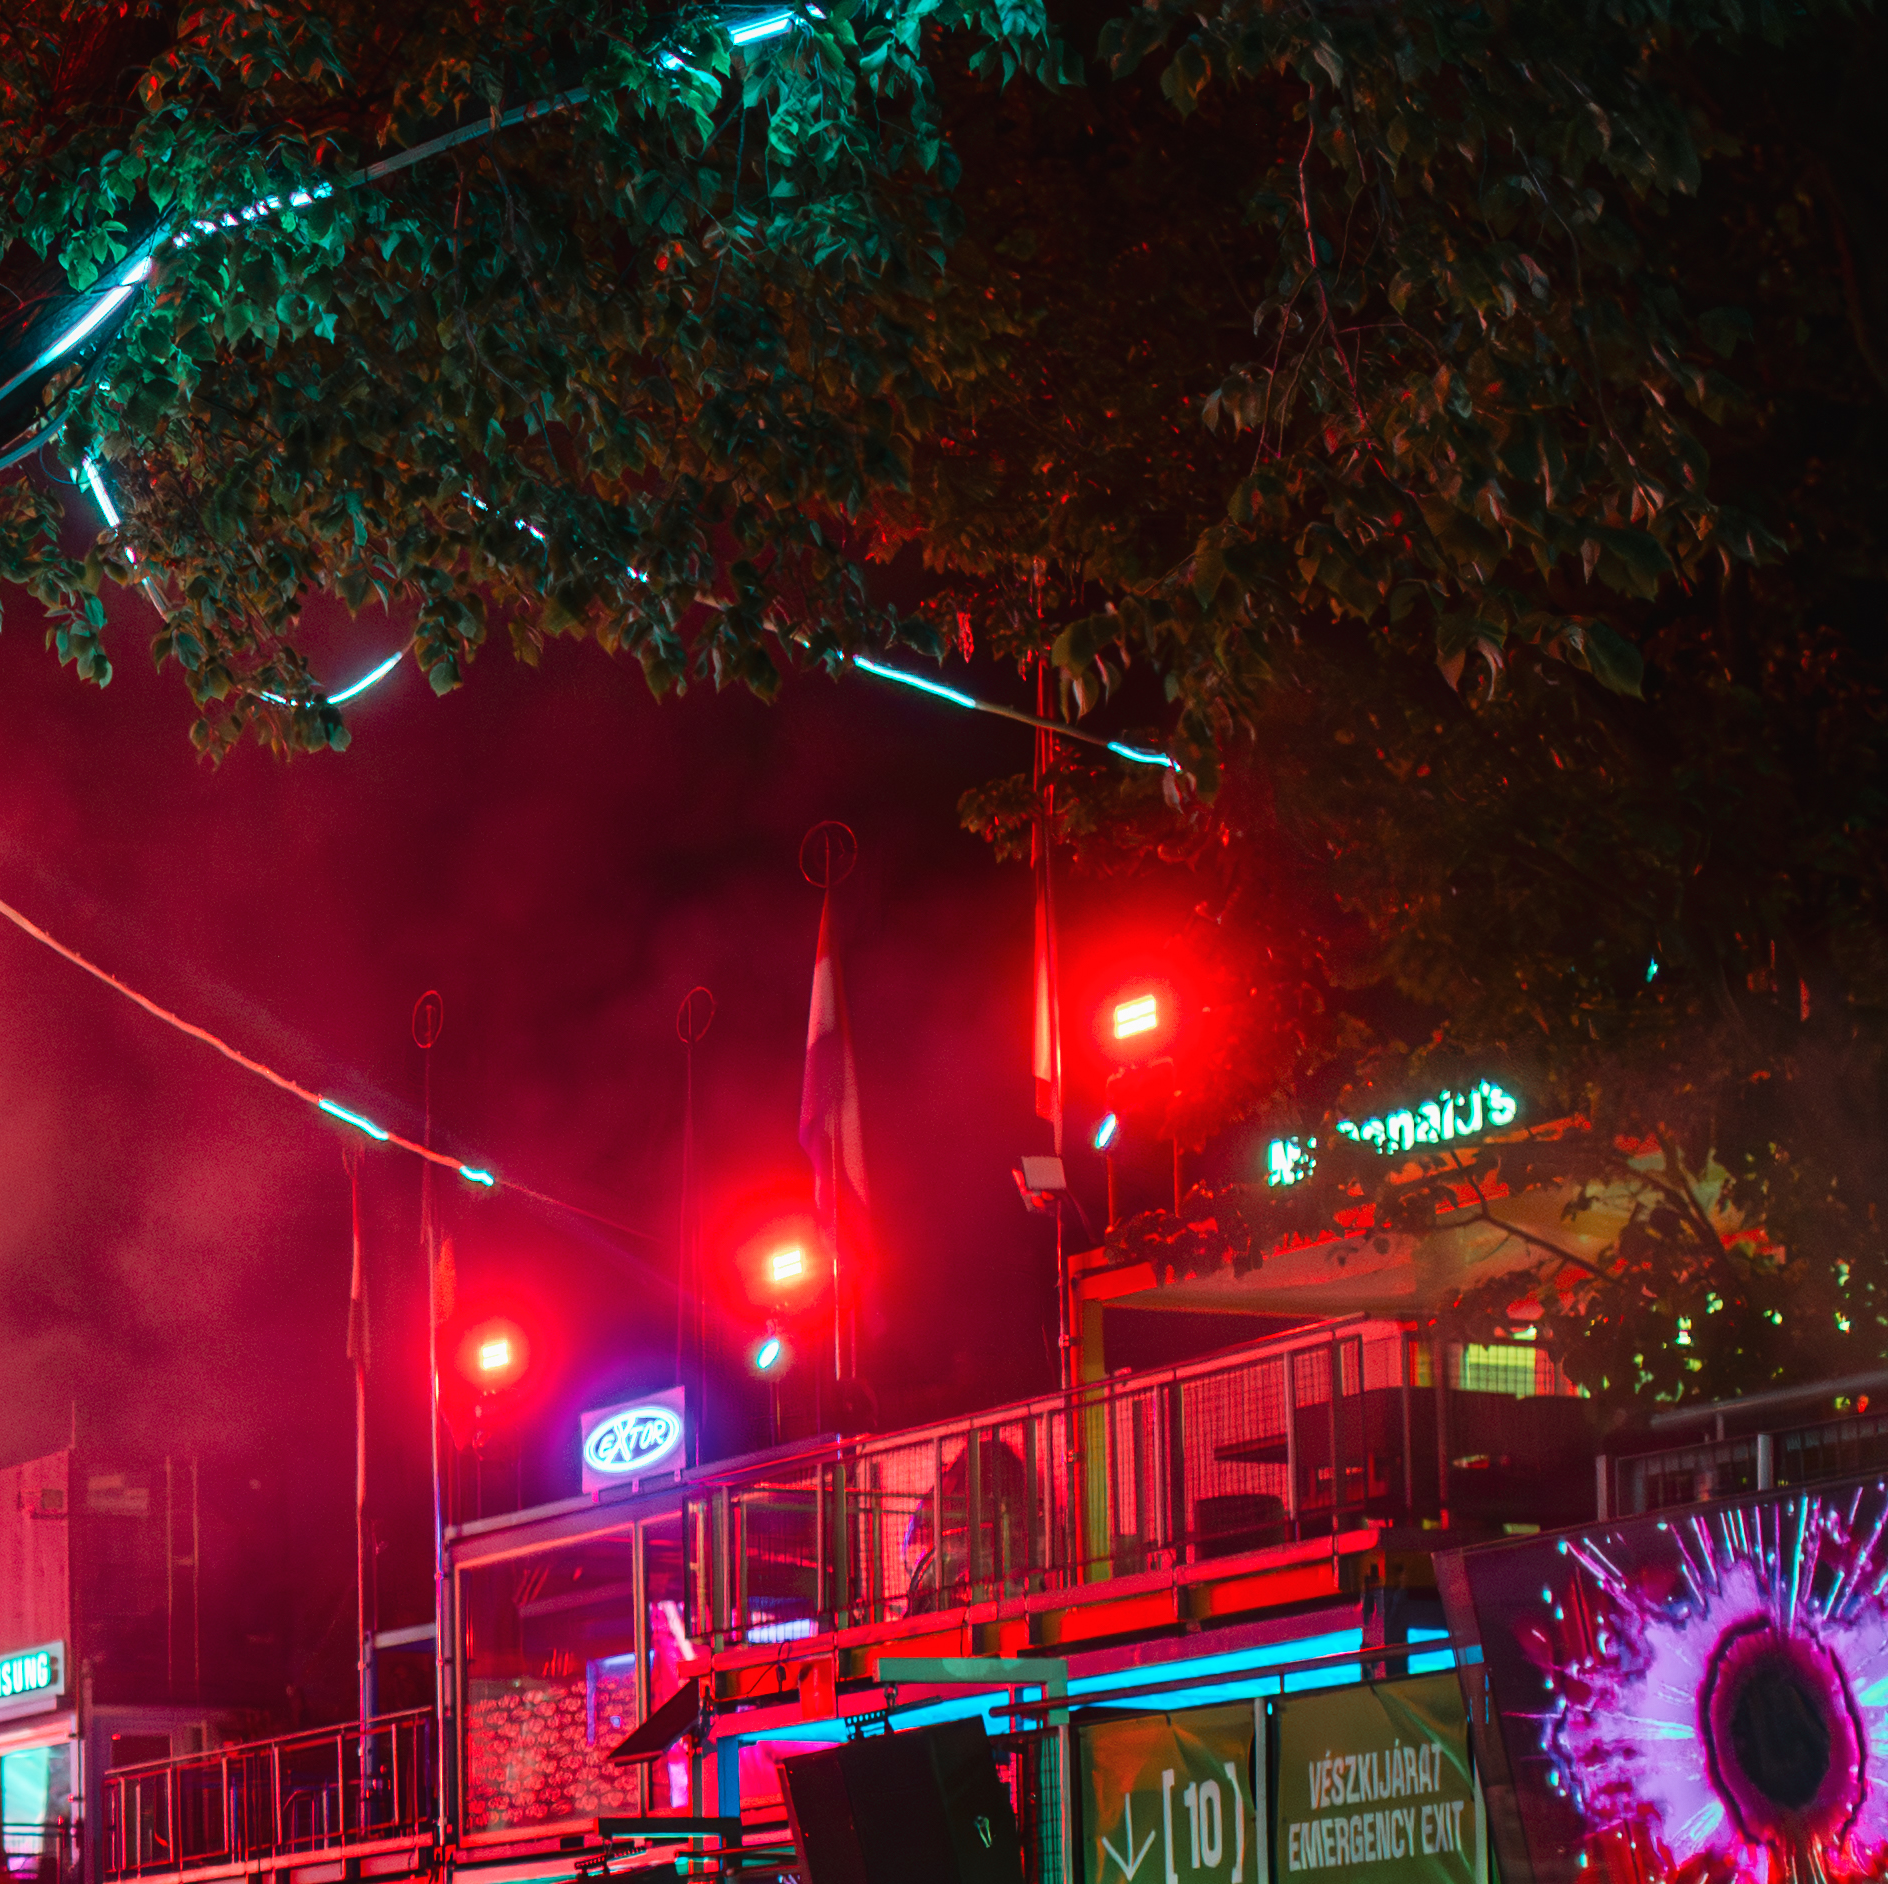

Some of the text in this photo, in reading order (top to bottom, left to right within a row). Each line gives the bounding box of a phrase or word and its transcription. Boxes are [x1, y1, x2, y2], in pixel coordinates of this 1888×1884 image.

[1309, 1738, 1442, 1811] VÉSZKIJÁRAT
[1289, 1800, 1464, 1872] EMERGENCY EXIT
